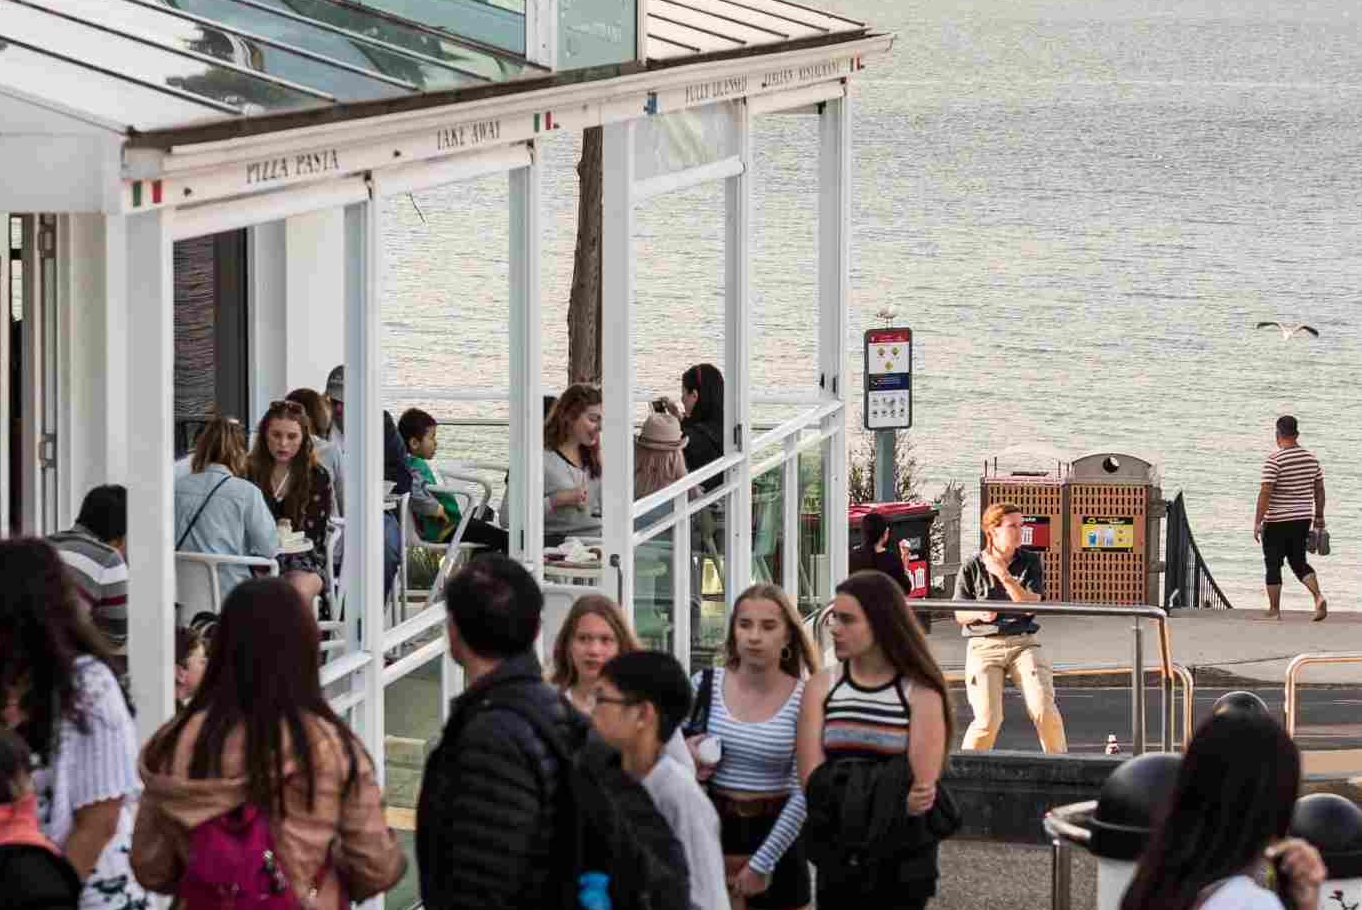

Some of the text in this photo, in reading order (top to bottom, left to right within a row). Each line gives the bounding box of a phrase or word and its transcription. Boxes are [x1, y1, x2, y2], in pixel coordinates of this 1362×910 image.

[437, 120, 502, 150] TAKE AWAY
[245, 149, 341, 184] PIZZA PASTA
